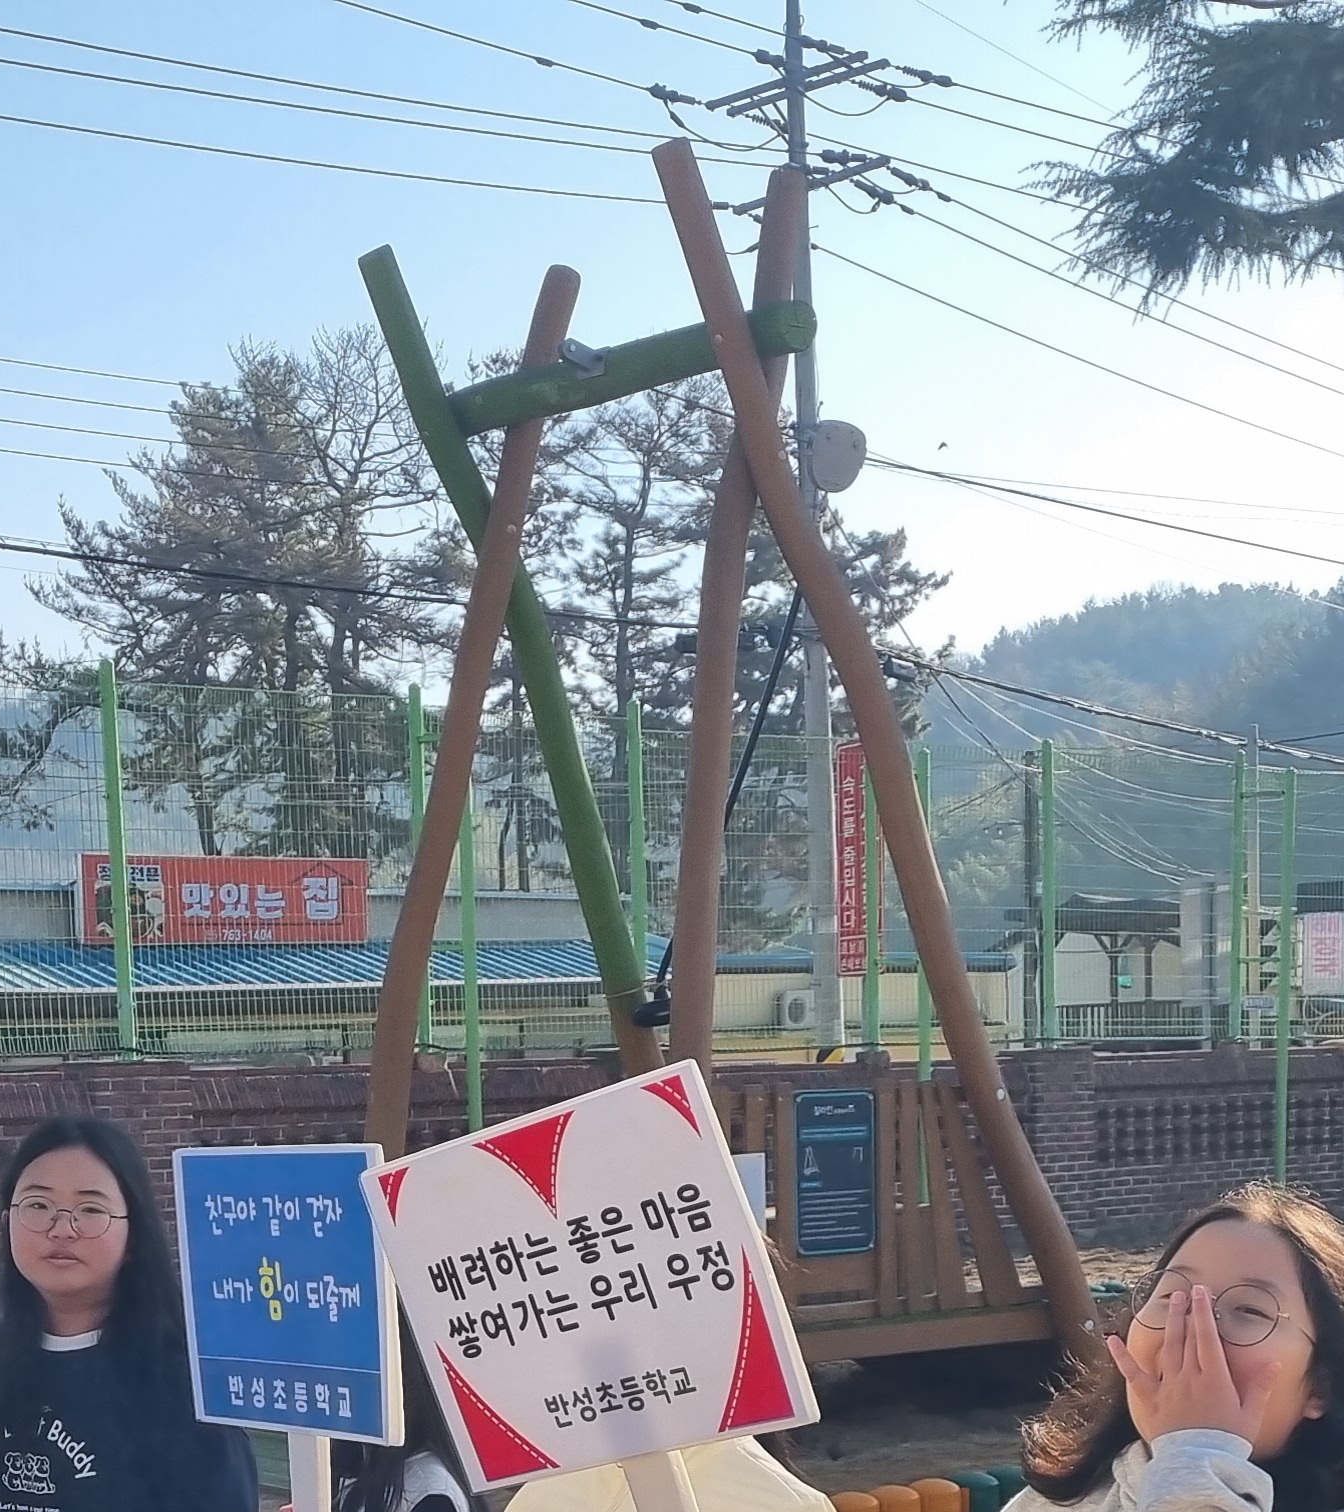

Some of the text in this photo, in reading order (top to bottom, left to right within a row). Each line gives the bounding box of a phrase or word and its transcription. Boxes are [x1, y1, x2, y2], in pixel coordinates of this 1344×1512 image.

[182, 876, 339, 920] 맛있는 집
[204, 1194, 343, 1238] 친구야 같이 걷자
[427, 1182, 712, 1302] 배려하는 좋은 마음
[212, 1256, 362, 1323] 내가 힘이 되줄께
[447, 1240, 736, 1359] 쌓여가는 우리 우정
[228, 1374, 353, 1418] 반성초등학교
[543, 1365, 698, 1429] 반성초등학교
[46, 1418, 97, 1480] Buddy
